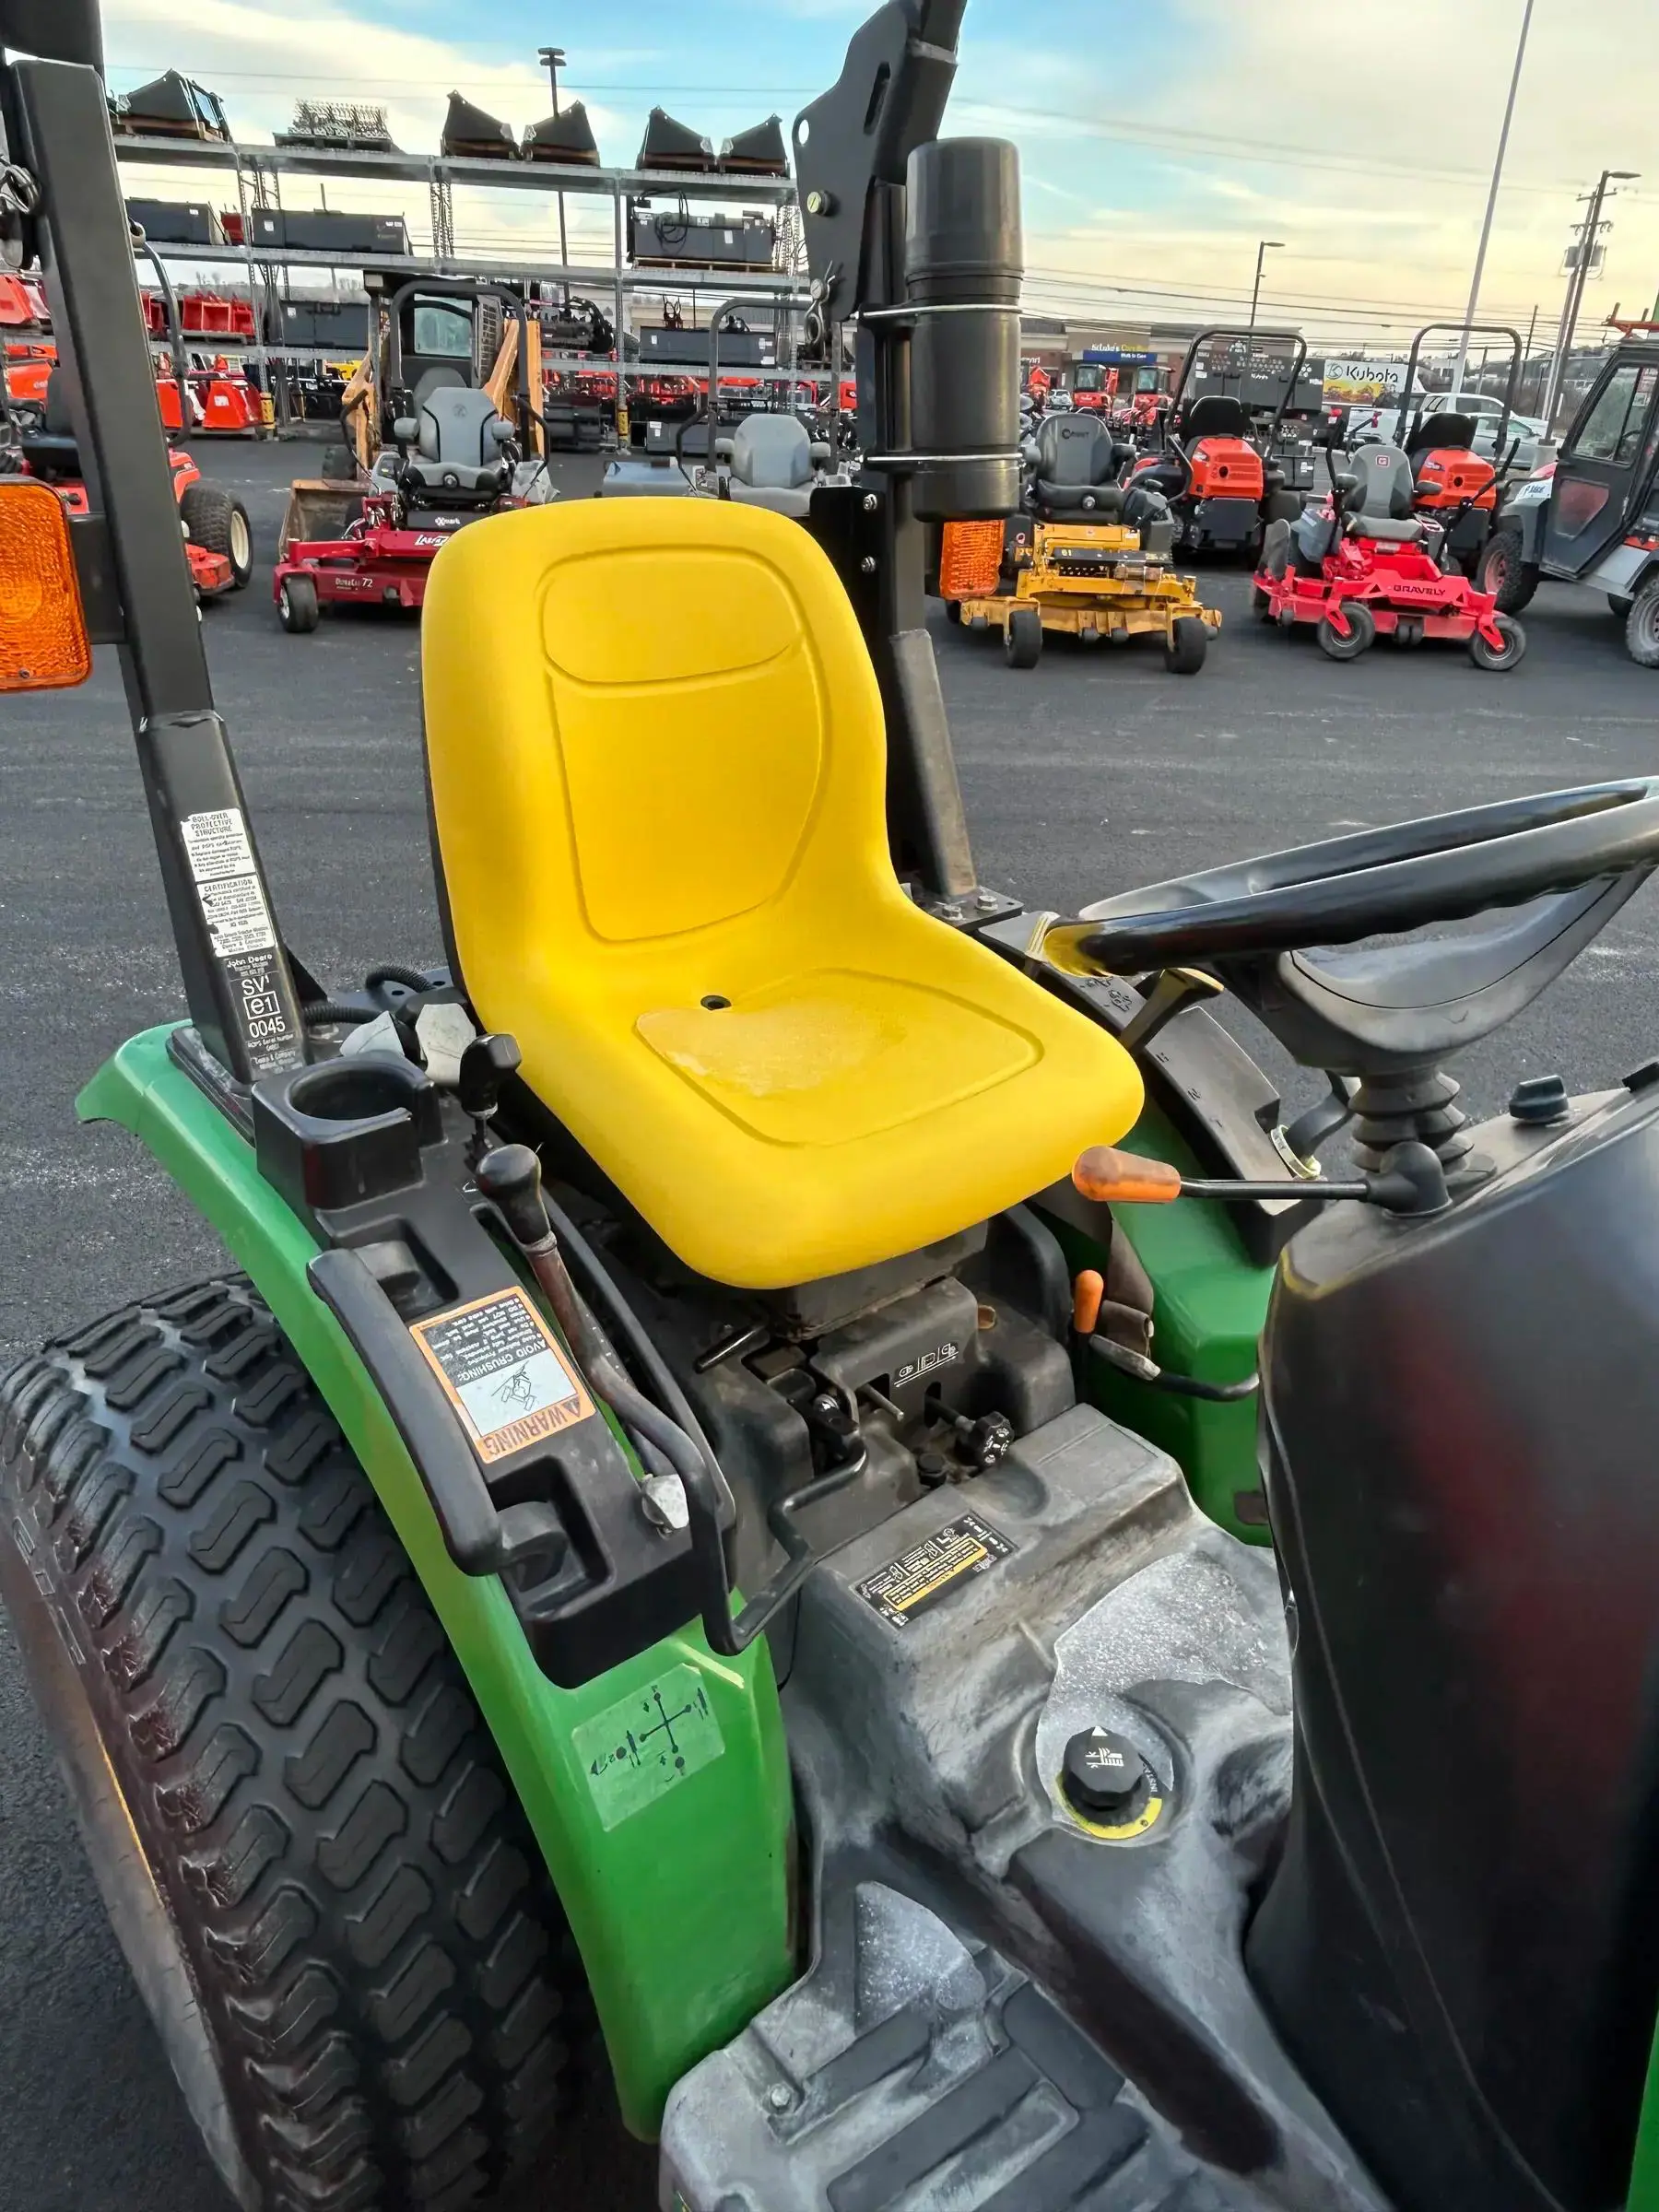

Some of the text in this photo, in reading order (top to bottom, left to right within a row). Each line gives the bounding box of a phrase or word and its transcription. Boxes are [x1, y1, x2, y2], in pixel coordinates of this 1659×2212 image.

[1347, 365, 1399, 382] Kubota
[362, 577, 373, 587] 72
[1394, 584, 1446, 595] GRAVELY
[250, 996, 274, 1015] e1
[249, 1016, 286, 1039] 0045
[515, 1339, 547, 1359] AVOID
[484, 1407, 568, 1455] WARNING
